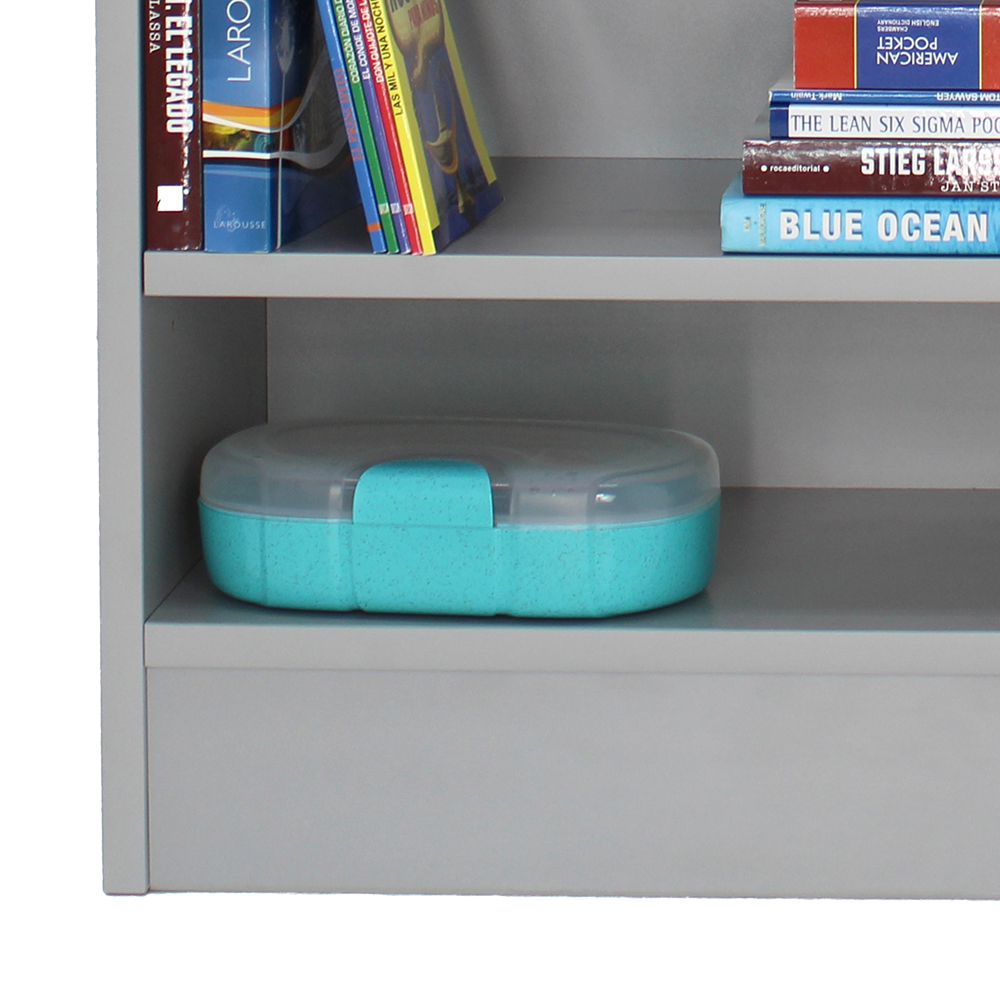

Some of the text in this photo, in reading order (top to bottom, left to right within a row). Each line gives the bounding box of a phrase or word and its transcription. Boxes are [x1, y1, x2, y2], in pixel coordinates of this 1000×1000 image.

[337, 5, 350, 37] DIARIO
[361, 10, 371, 20] DE
[351, 19, 360, 33] DE
[877, 19, 940, 27] ENGLISH DICTIONARY
[364, 21, 379, 61] QUIJOTE
[379, 35, 391, 60] UNA
[876, 36, 938, 51] POCKET
[354, 33, 368, 67] CONDE
[876, 51, 959, 65] AMERICAN
[373, 61, 384, 83] DON
[384, 62, 393, 70] Y
[361, 68, 370, 80] EL
[387, 72, 398, 91] MIL
[165, 47, 194, 135] LEGADO
[819, 92, 843, 101] Mark
[936, 92, 978, 101] SAWYER
[980, 92, 1000, 101] TOM
[392, 93, 403, 116] LAS
[790, 114, 822, 132] THE
[830, 115, 872, 132] LEAN
[879, 115, 905, 133] SIX
[912, 116, 965, 133] SIGMA
[769, 164, 821, 173] rocaeditorial
[861, 147, 926, 176] STIEG
[940, 181, 974, 192] JAN
[213, 220, 267, 229] LAROUSSE
[779, 209, 863, 241] BLUE
[877, 210, 988, 243] OCEAN
